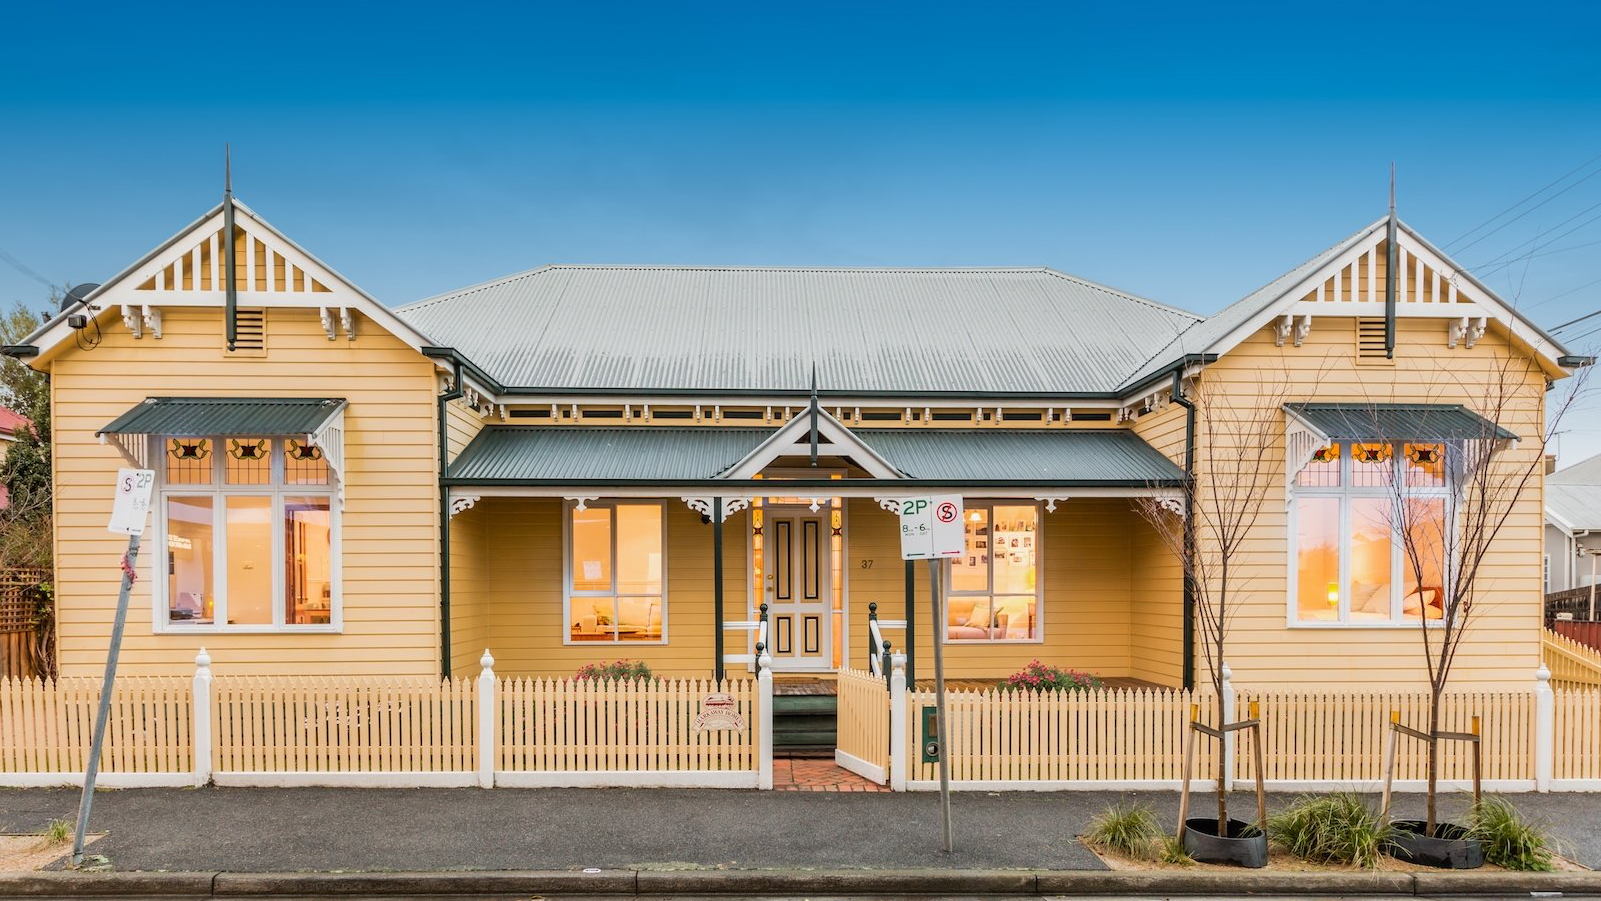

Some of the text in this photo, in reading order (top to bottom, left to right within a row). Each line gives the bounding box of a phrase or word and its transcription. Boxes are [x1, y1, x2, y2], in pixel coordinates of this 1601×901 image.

[136, 473, 152, 488] 2P
[903, 499, 927, 515] 2P
[861, 559, 874, 570] 37
